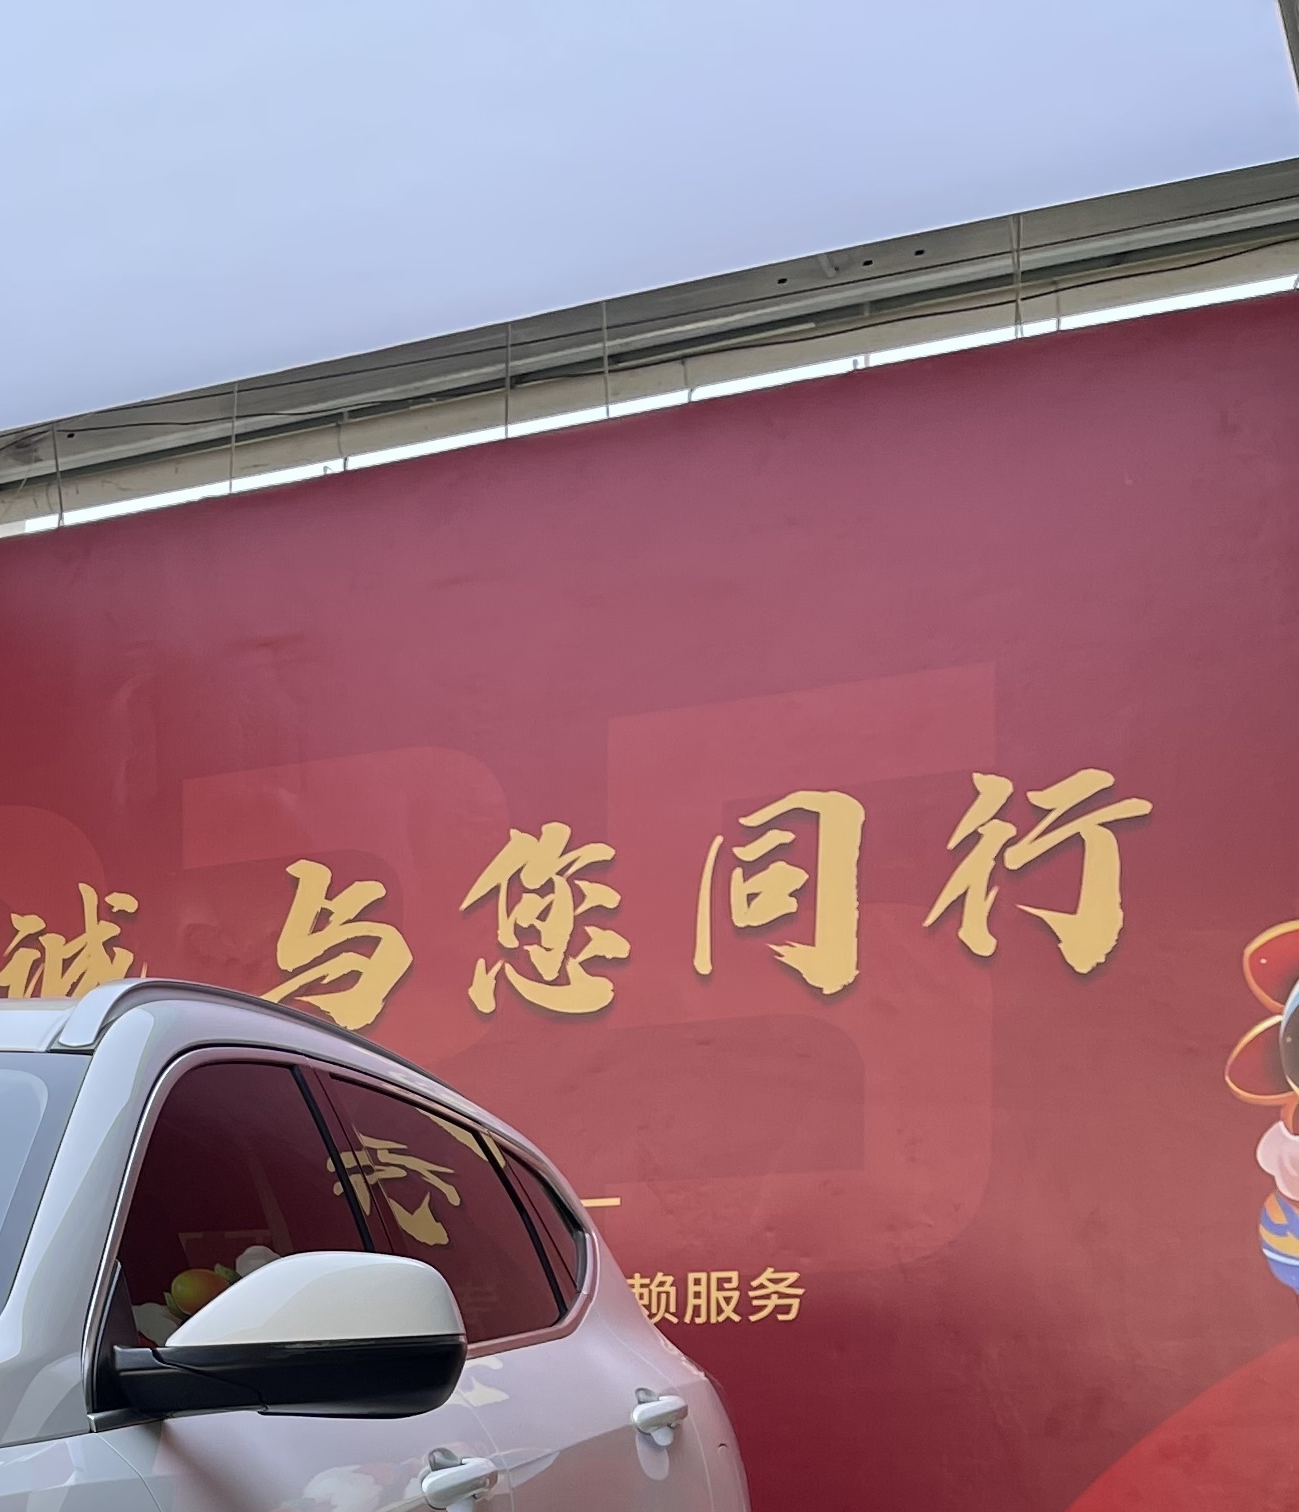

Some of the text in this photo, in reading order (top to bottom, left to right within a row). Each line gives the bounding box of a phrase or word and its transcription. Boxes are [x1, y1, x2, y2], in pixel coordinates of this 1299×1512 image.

[261, 767, 1153, 1032] 与您同行
[625, 1266, 806, 1325] 赖服务
